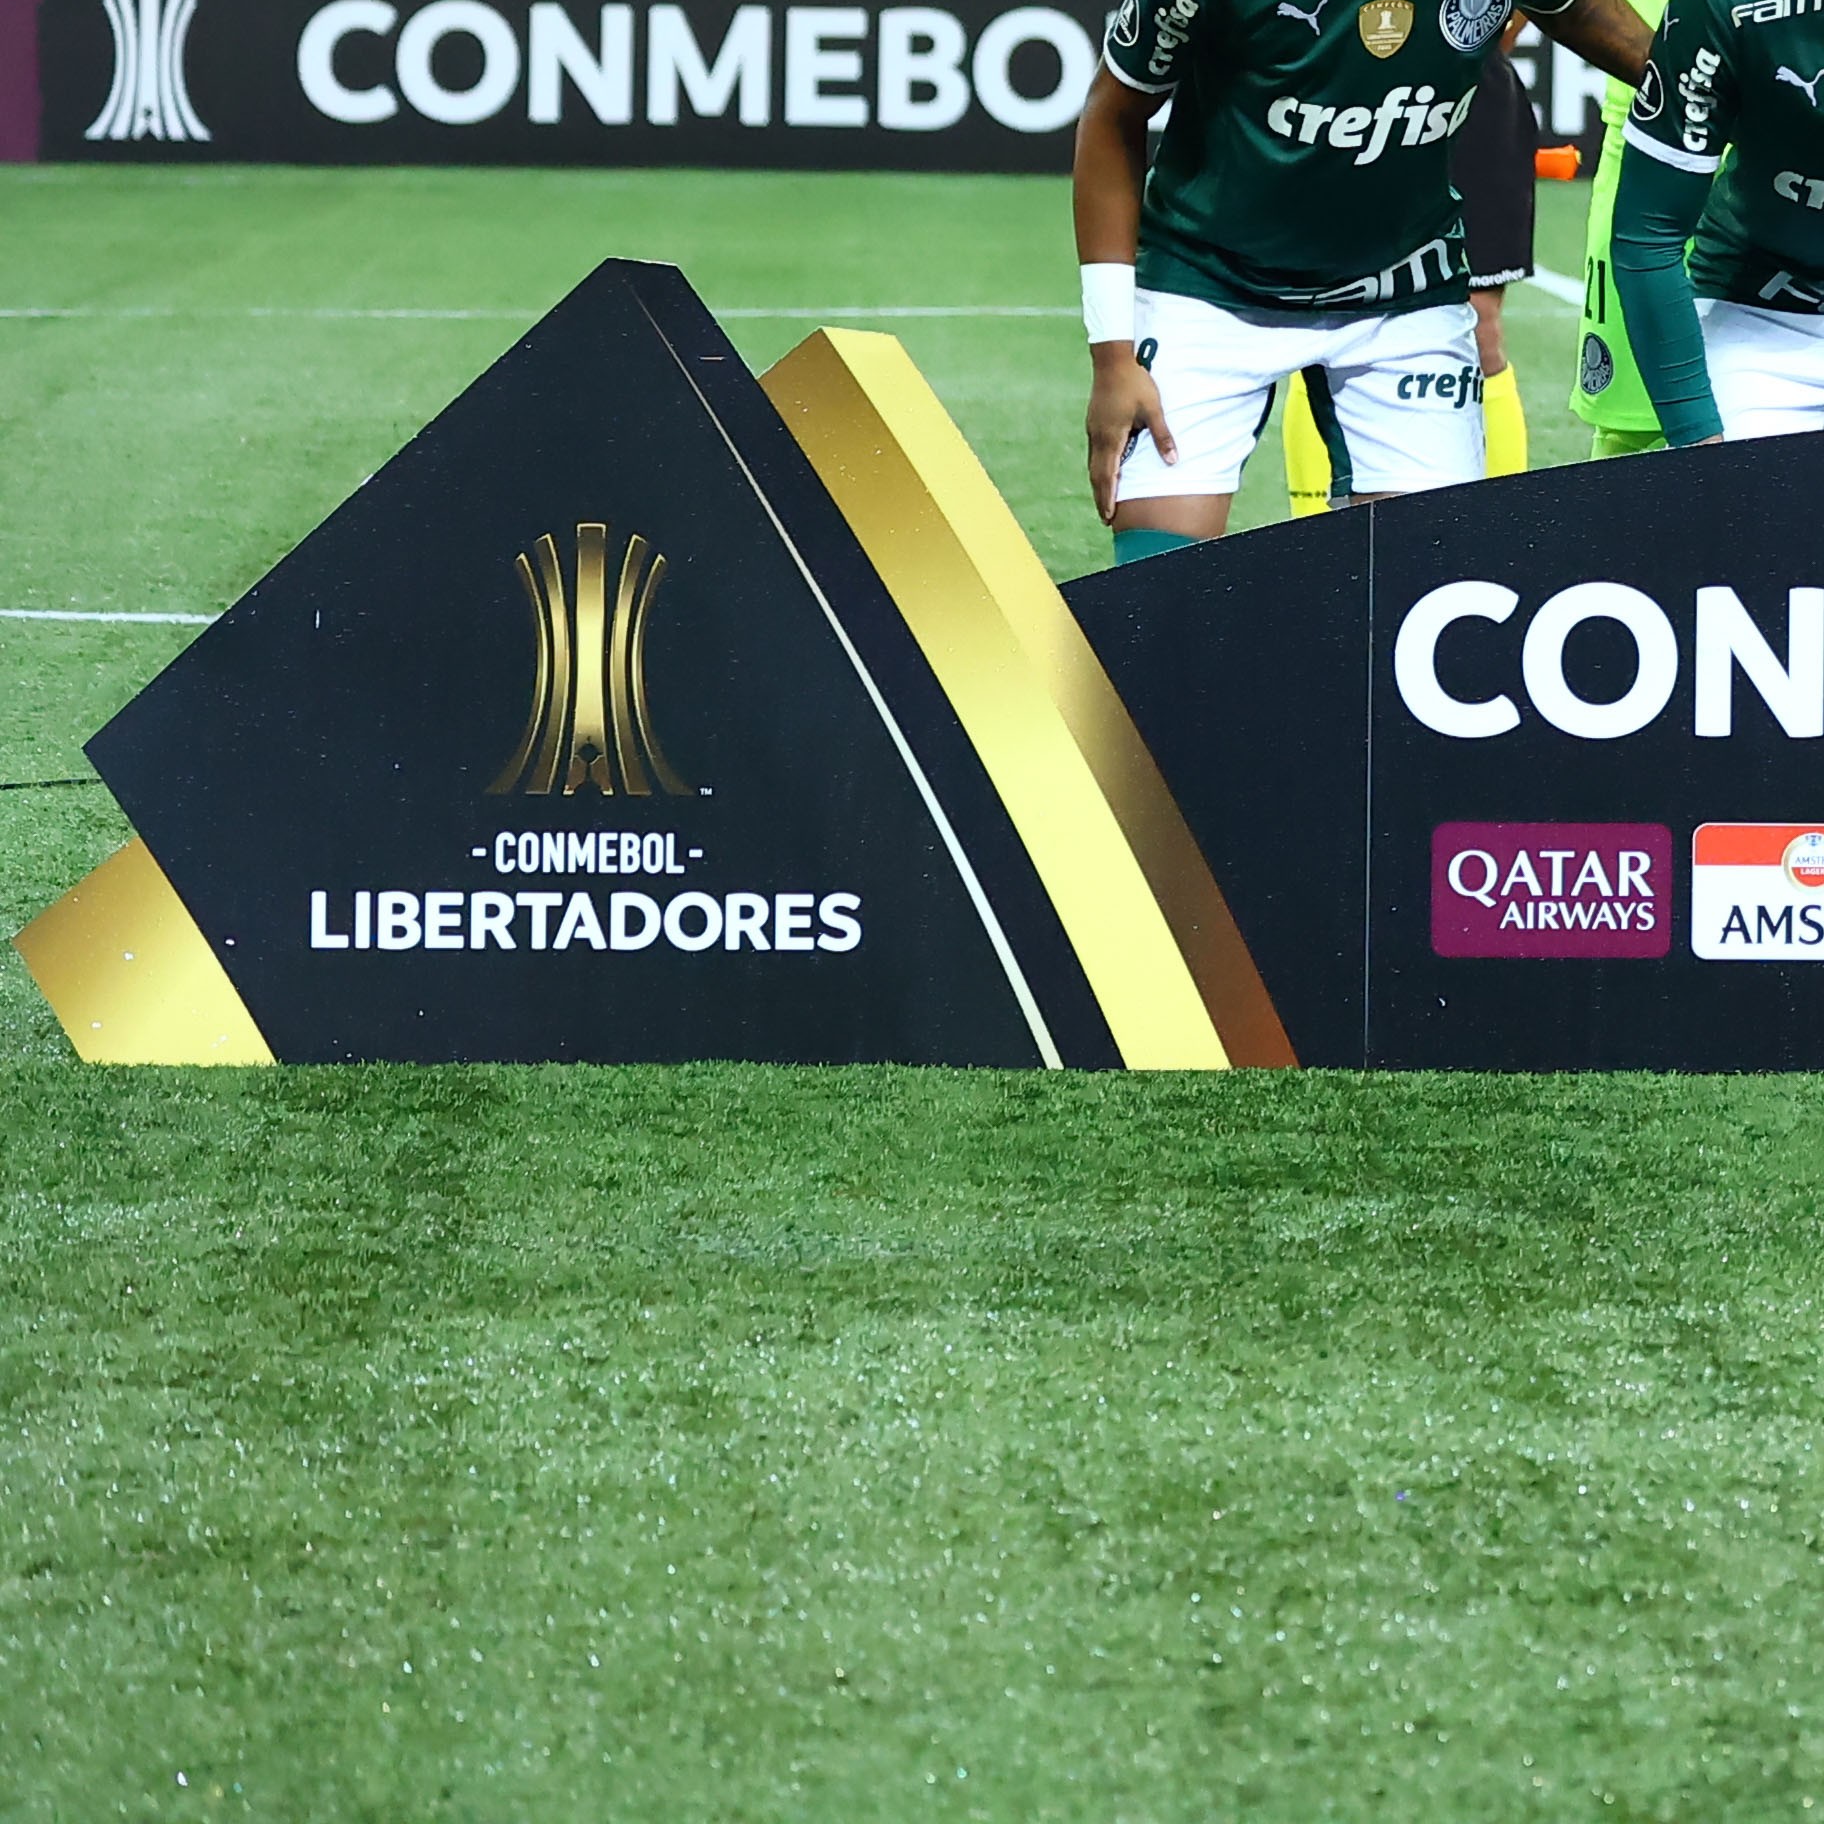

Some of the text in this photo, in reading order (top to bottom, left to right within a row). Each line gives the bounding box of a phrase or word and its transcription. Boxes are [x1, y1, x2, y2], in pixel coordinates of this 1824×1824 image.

[1446, 2, 1504, 46] PALMEIRAS
[1268, 84, 1477, 166] crefisa
[1682, 47, 1721, 153] crefisa
[1584, 256, 1606, 324] 21
[1397, 365, 1484, 409] crefi
[494, 831, 686, 874] CONMEBOL
[1447, 849, 1656, 908] QATAR
[310, 890, 863, 953] LIBERTADORES
[1499, 901, 1656, 932] AIRWAYS
